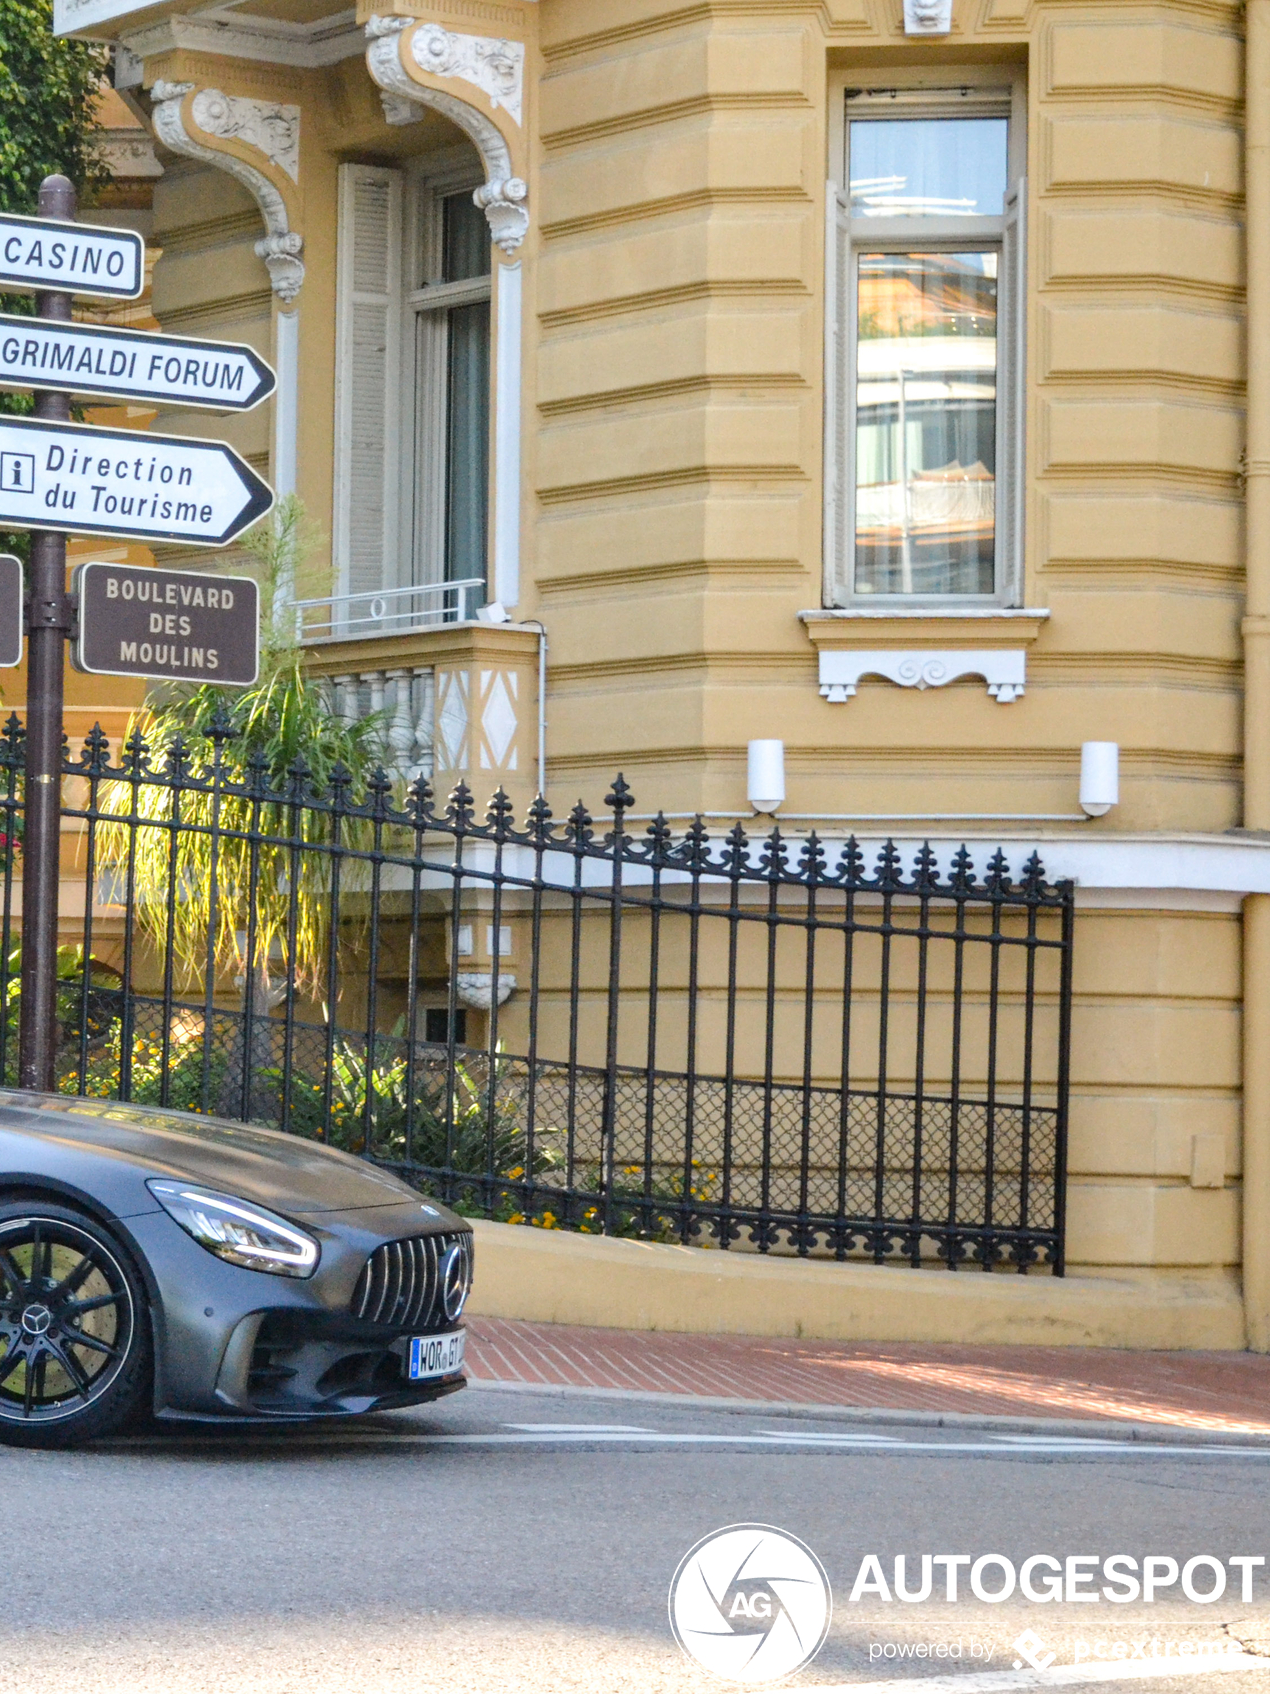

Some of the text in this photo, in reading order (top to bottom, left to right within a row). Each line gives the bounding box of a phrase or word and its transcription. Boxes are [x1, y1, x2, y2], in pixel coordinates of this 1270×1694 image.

[4, 237, 124, 277] CASINO
[2, 338, 244, 391] GRIMALDI FORUM
[46, 445, 192, 486] Direction
[45, 484, 213, 523] du Tourisme
[106, 578, 234, 610] BOULEVARD
[149, 613, 191, 636] DES
[121, 642, 219, 669] MOULINS
